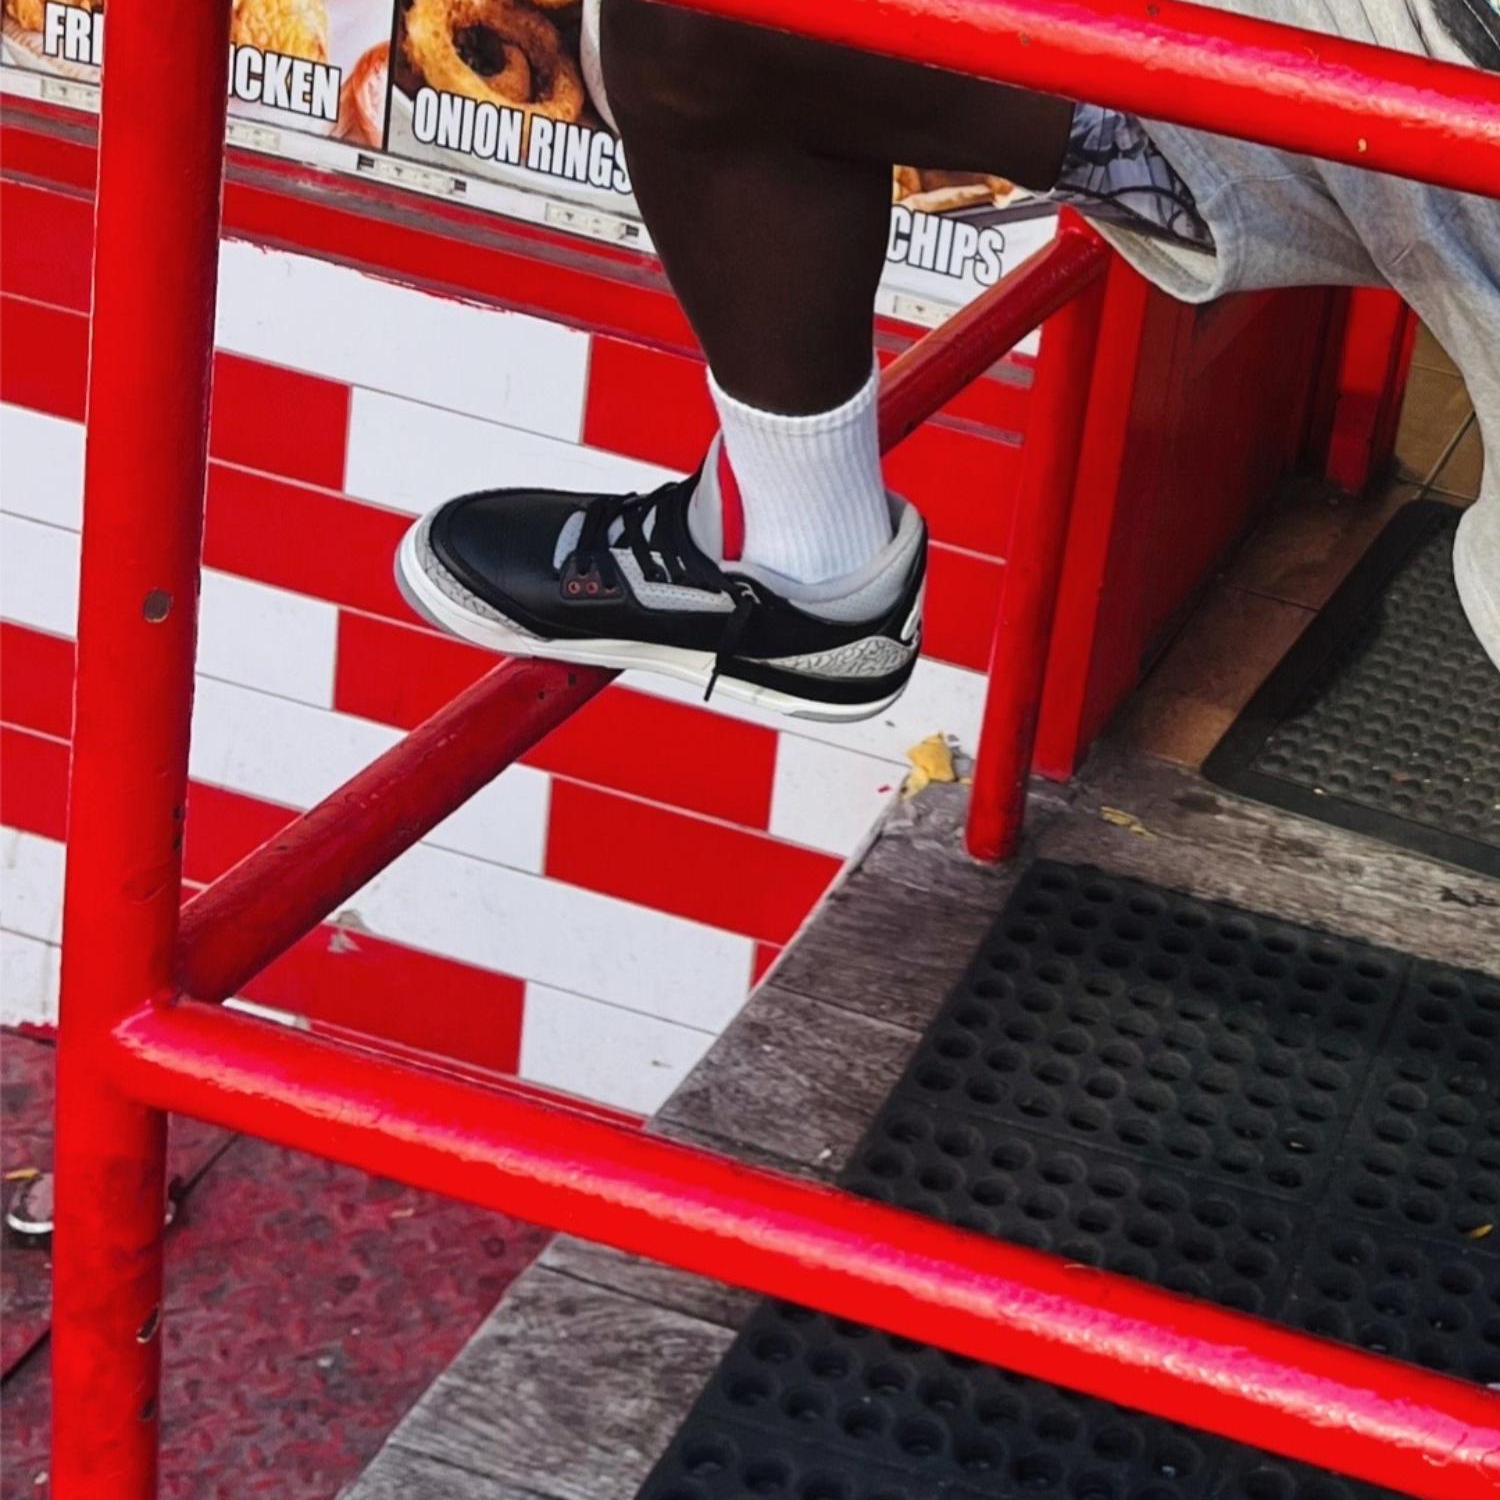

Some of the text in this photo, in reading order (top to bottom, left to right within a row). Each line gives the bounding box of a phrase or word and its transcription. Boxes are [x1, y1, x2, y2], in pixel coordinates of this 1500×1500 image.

[412, 88, 634, 195] ONION RINGS
[887, 203, 1004, 286] CHIPS
